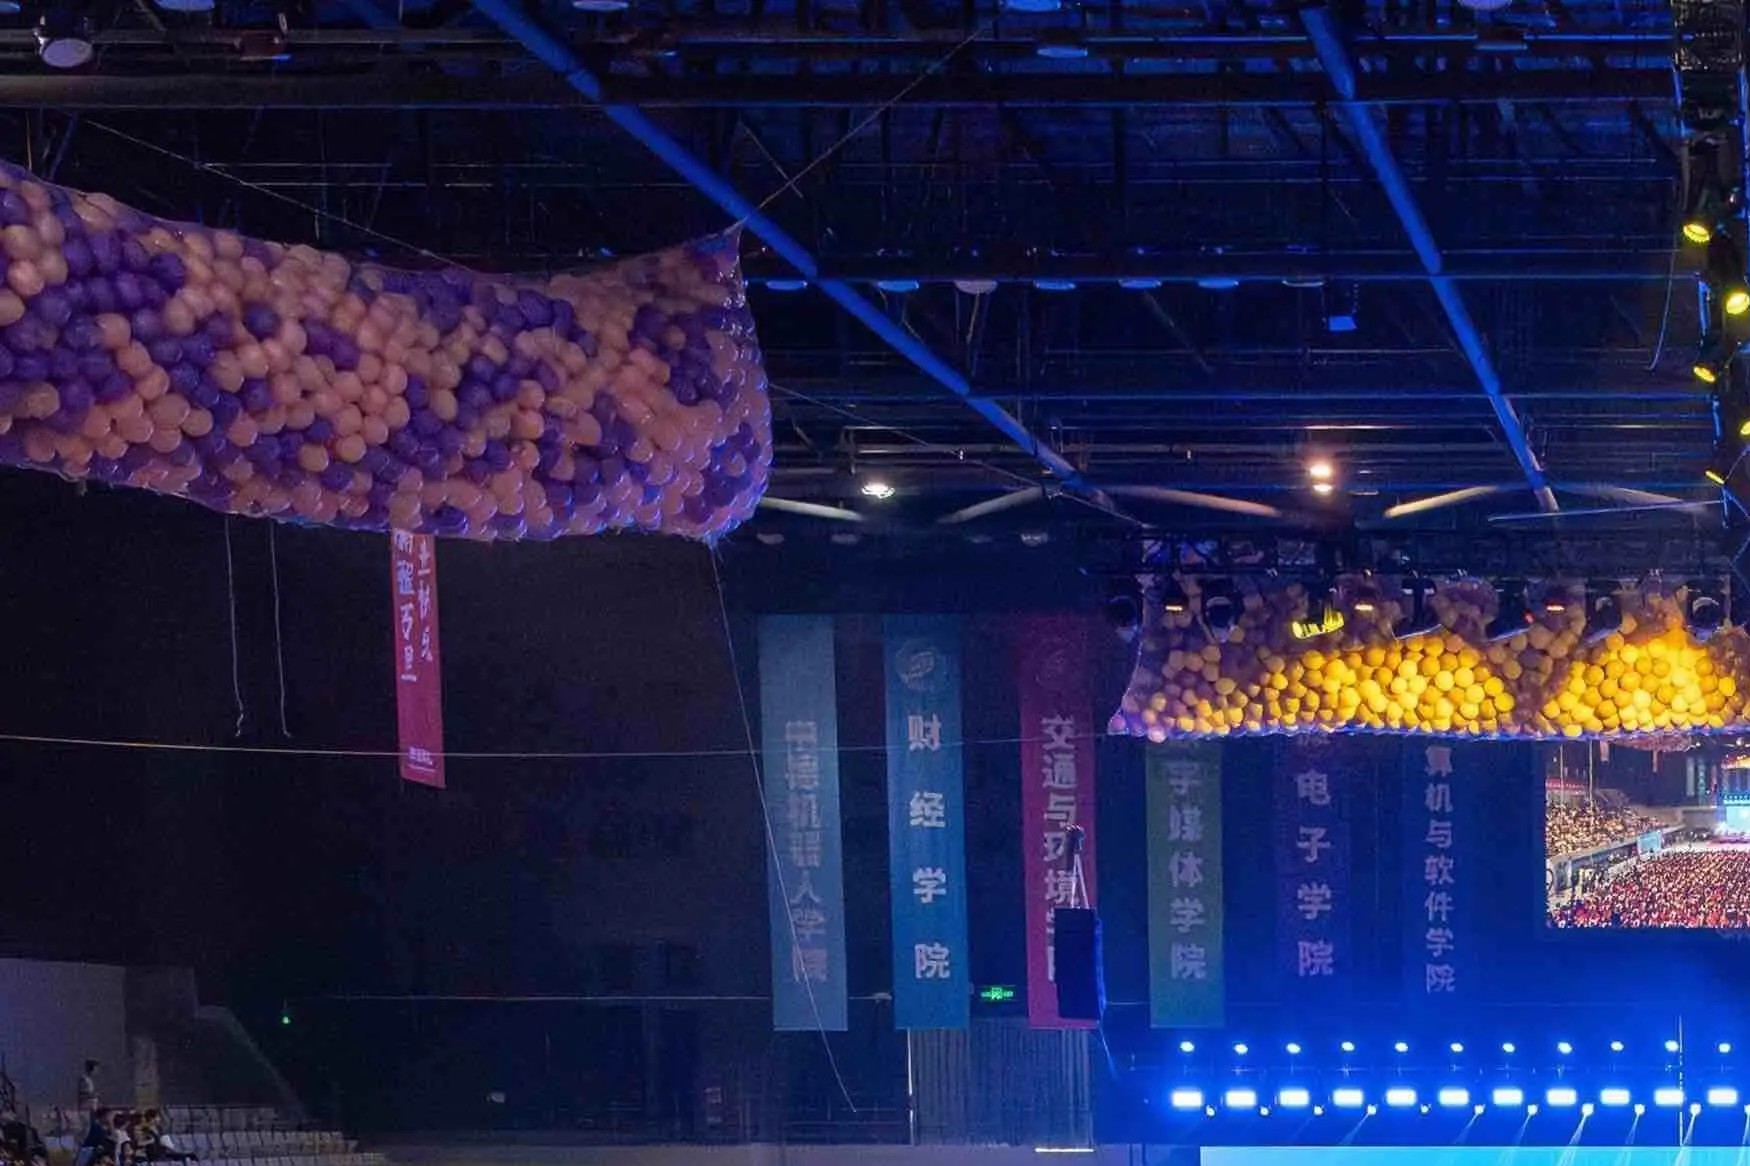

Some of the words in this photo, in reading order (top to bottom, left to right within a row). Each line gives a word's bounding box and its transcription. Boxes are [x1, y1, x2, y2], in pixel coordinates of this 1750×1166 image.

[906, 711, 952, 981] 财经学院
[1040, 713, 1083, 983] 交通与环境
[1163, 738, 1208, 981] 字媒体学院
